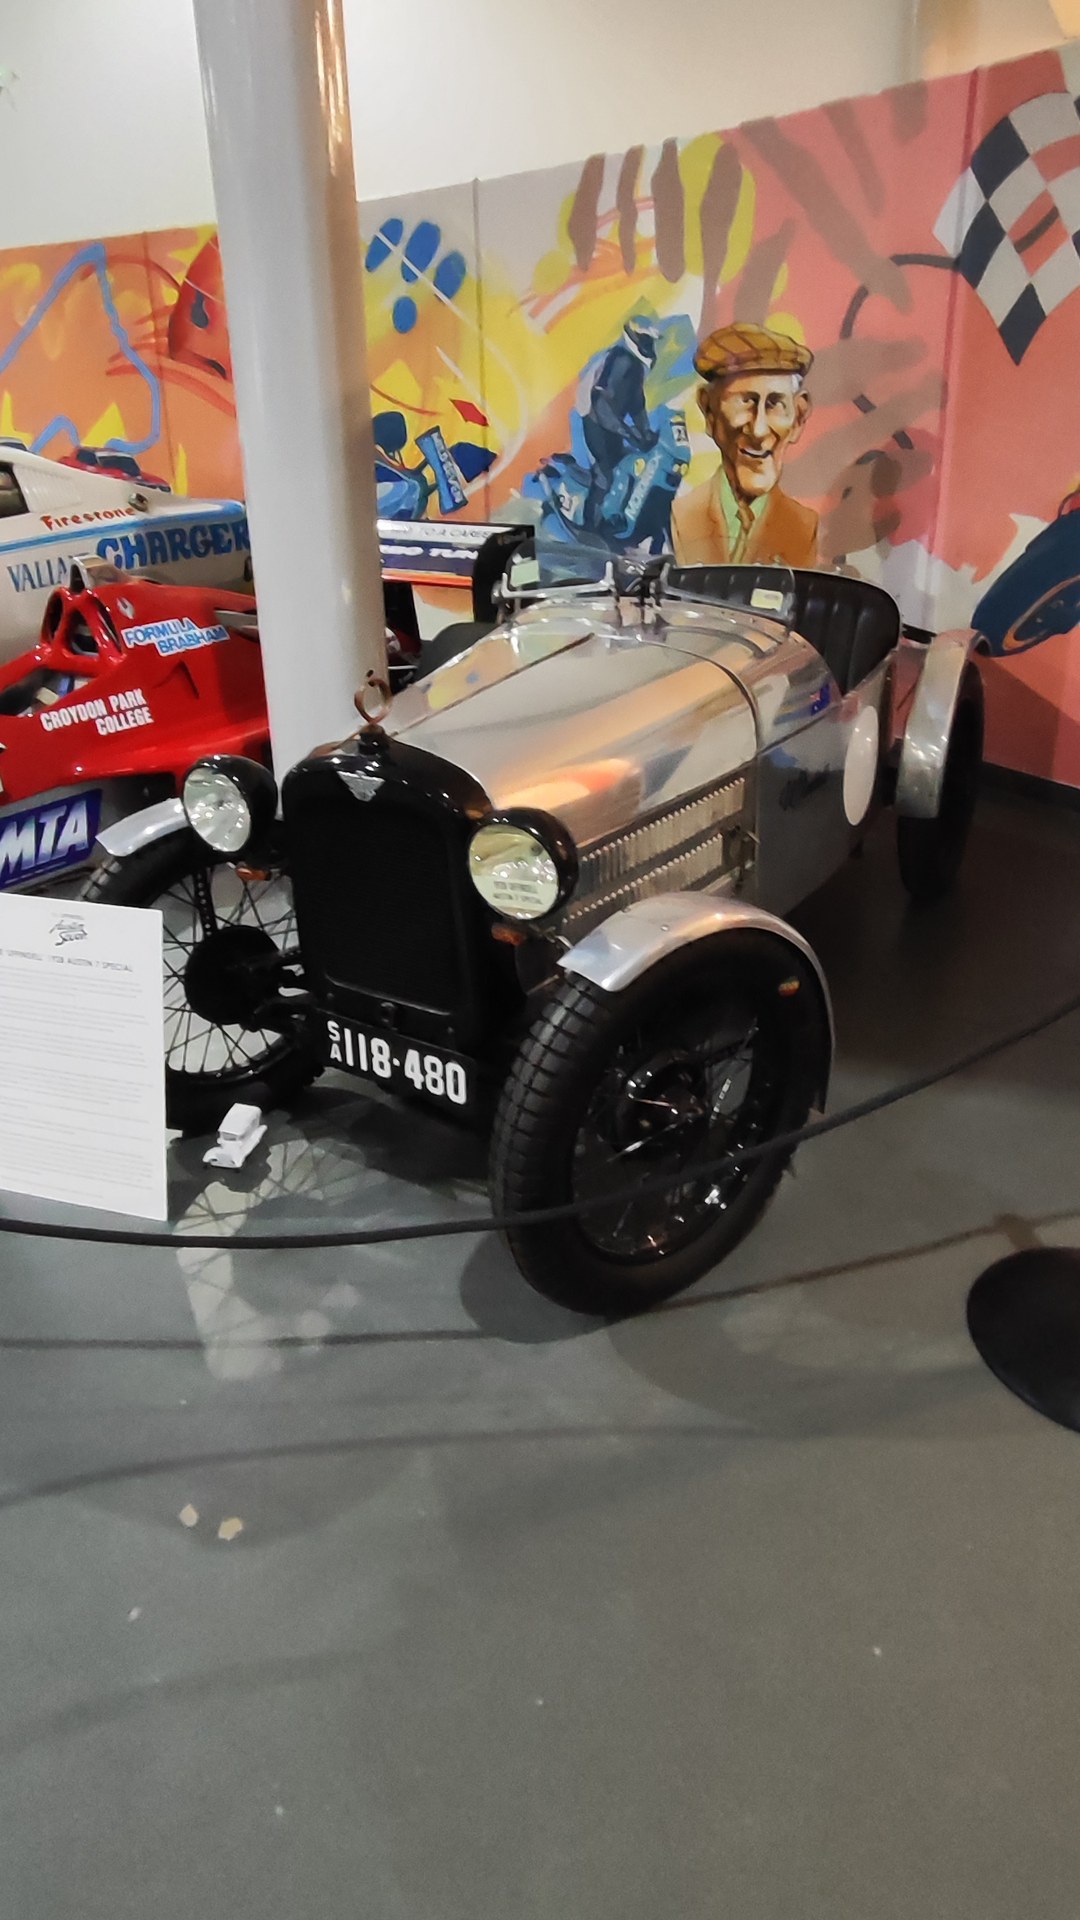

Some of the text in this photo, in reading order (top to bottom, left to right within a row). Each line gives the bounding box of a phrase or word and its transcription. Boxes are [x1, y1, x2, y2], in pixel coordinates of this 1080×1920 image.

[40, 507, 136, 531] Firestone
[7, 552, 90, 593] VALIA
[125, 619, 197, 646] FORMULA
[158, 627, 228, 654] BRABHAM
[41, 688, 147, 732] CROYDON PARK
[95, 706, 155, 736] COLLEGE
[0, 800, 90, 877] MTA
